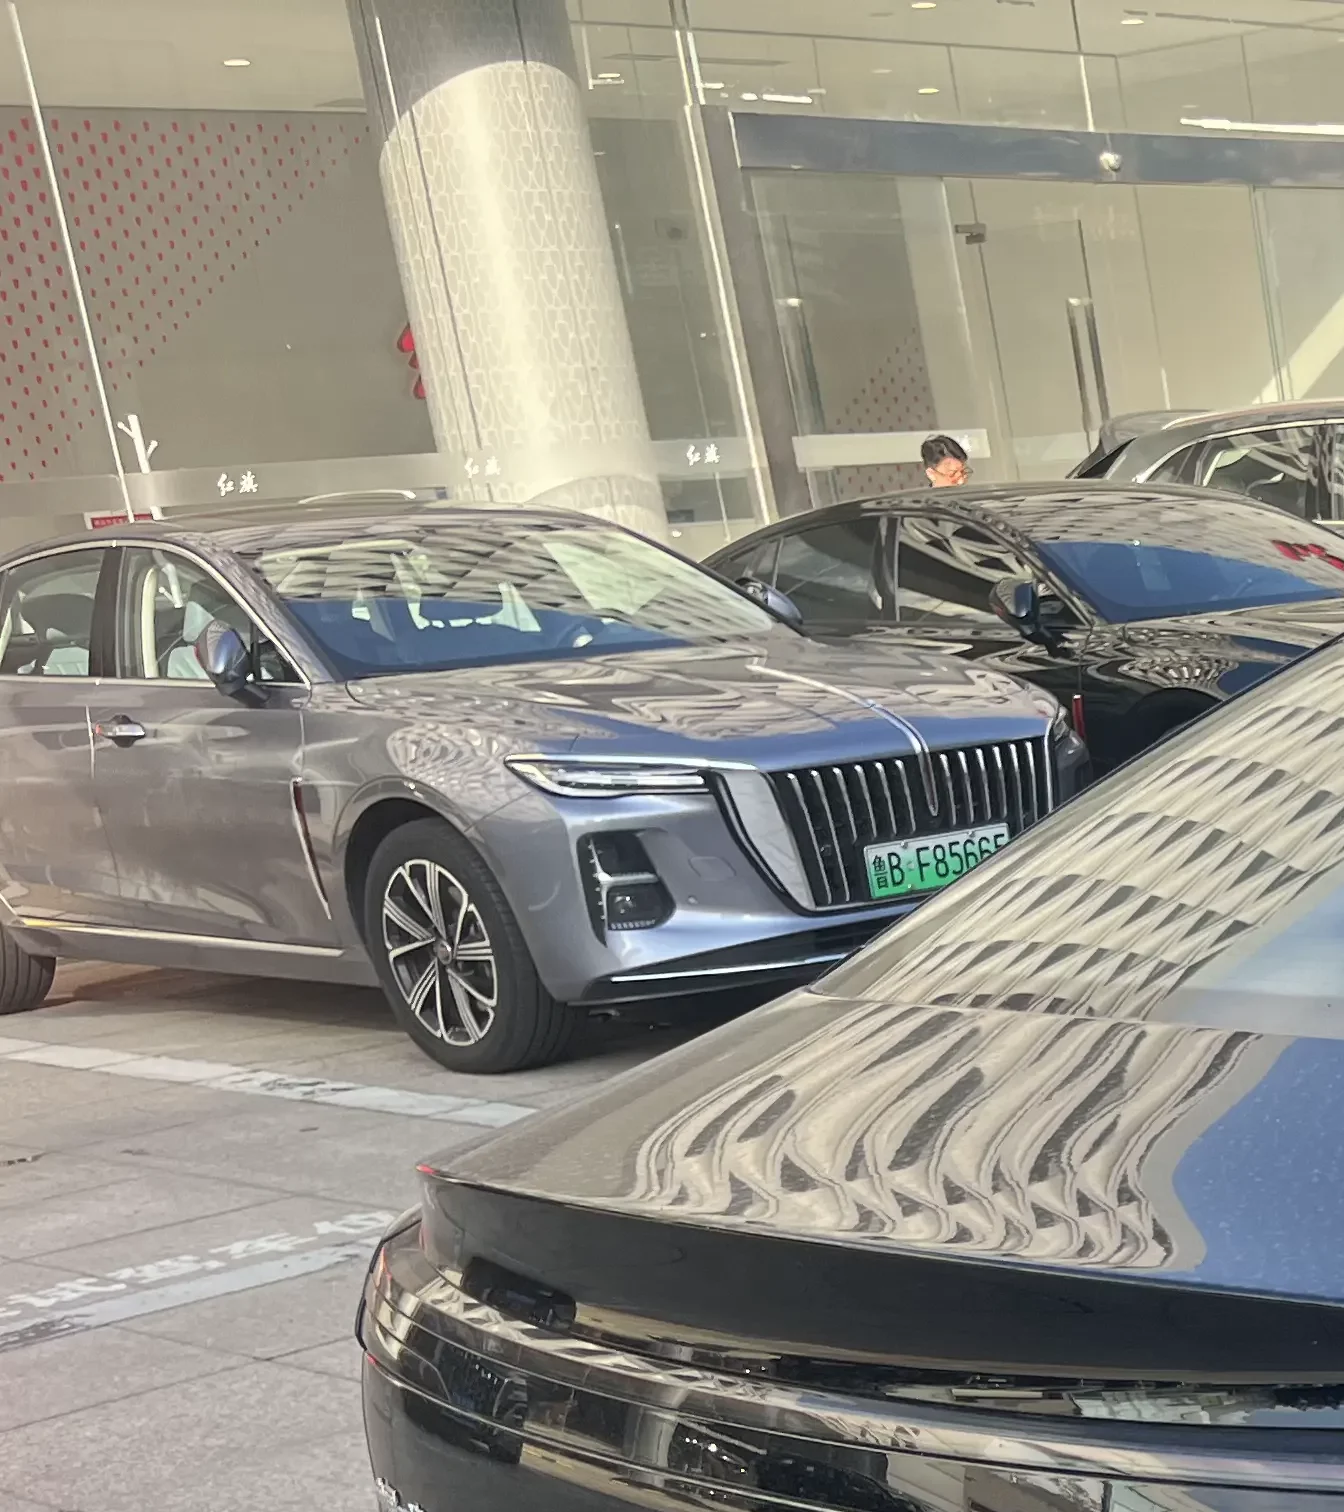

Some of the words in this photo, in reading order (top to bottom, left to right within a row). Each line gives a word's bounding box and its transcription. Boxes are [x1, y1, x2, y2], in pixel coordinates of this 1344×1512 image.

[464, 455, 503, 478] 红旗
[686, 444, 721, 466] 红旗
[216, 471, 259, 498] 红旗
